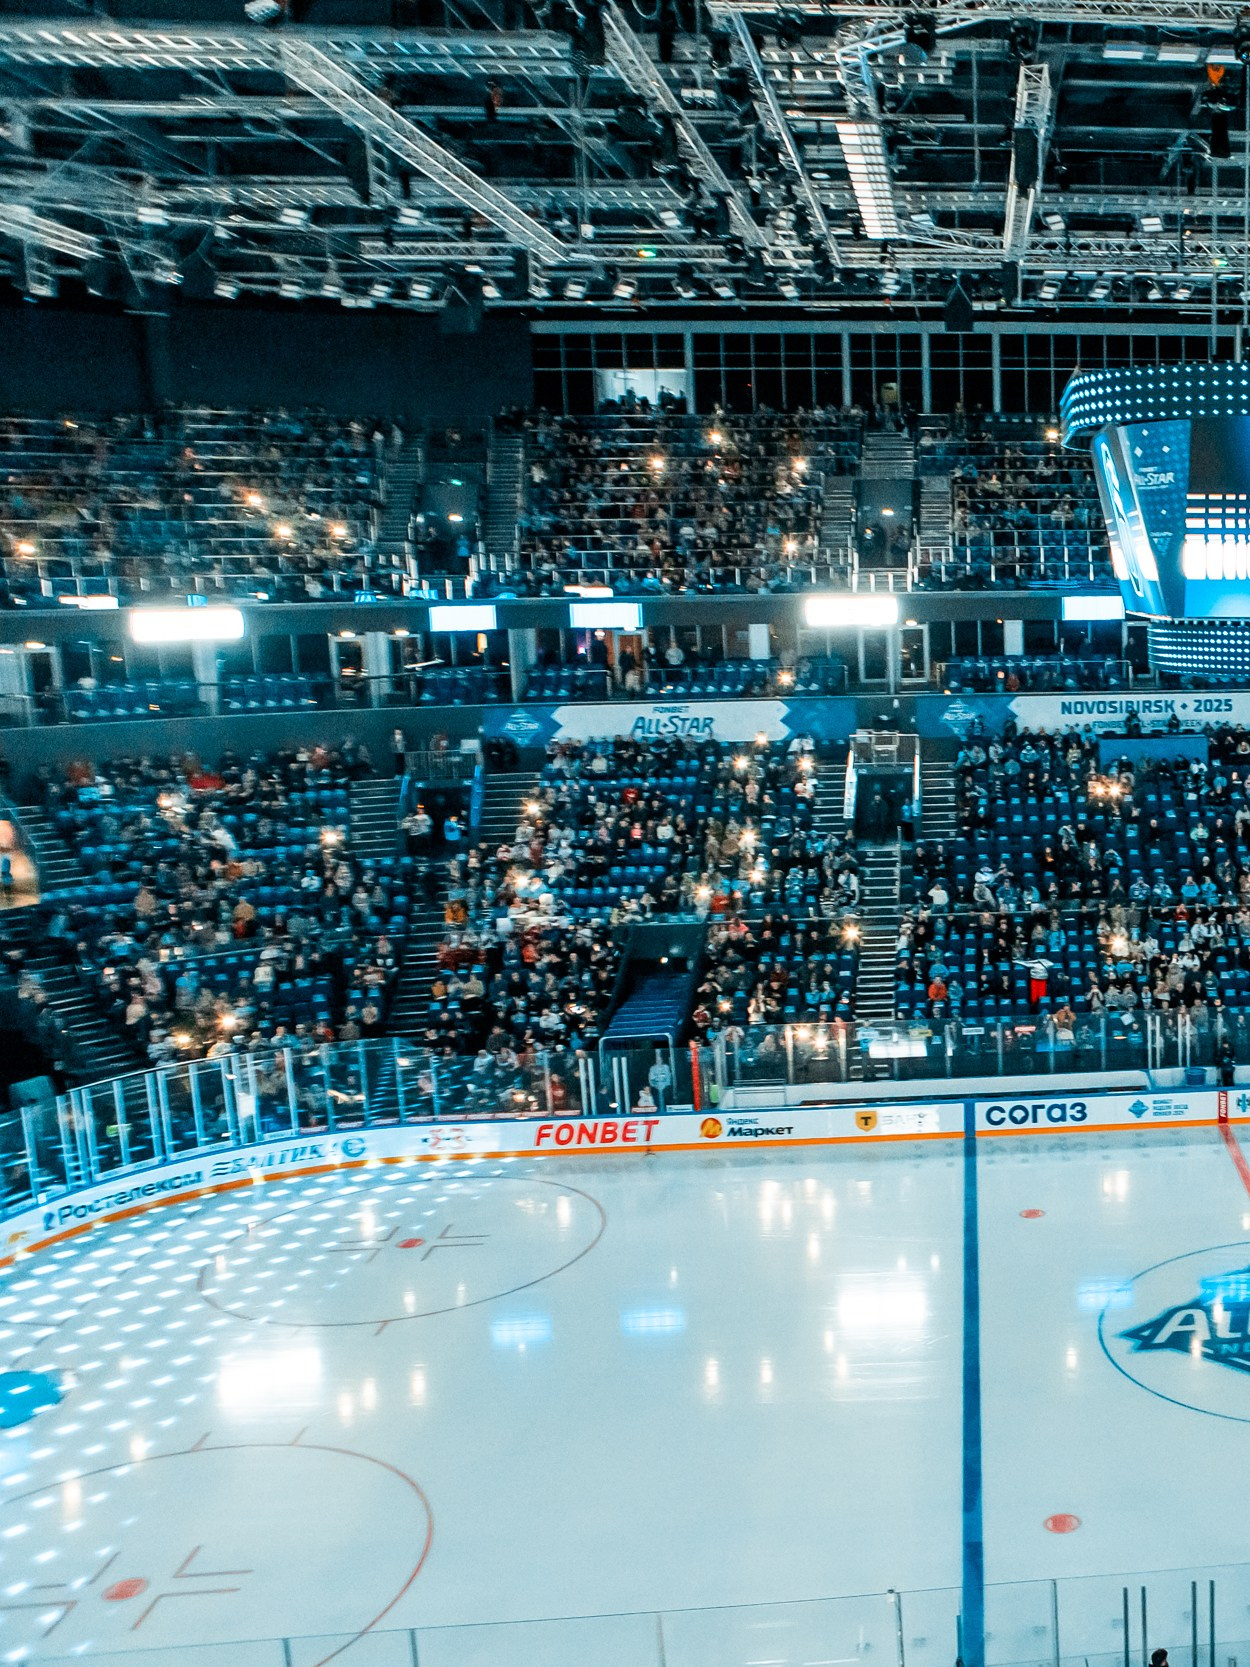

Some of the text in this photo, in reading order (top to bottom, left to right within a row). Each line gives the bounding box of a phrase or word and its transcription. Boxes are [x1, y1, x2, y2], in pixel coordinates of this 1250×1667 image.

[653, 705, 690, 713] FONBET
[1061, 699, 1233, 714] NOVOSIBIRSK 2025
[535, 1119, 660, 1147] FONBET
[727, 1126, 794, 1138] Маркет
[58, 1171, 202, 1225] Ростелеком
